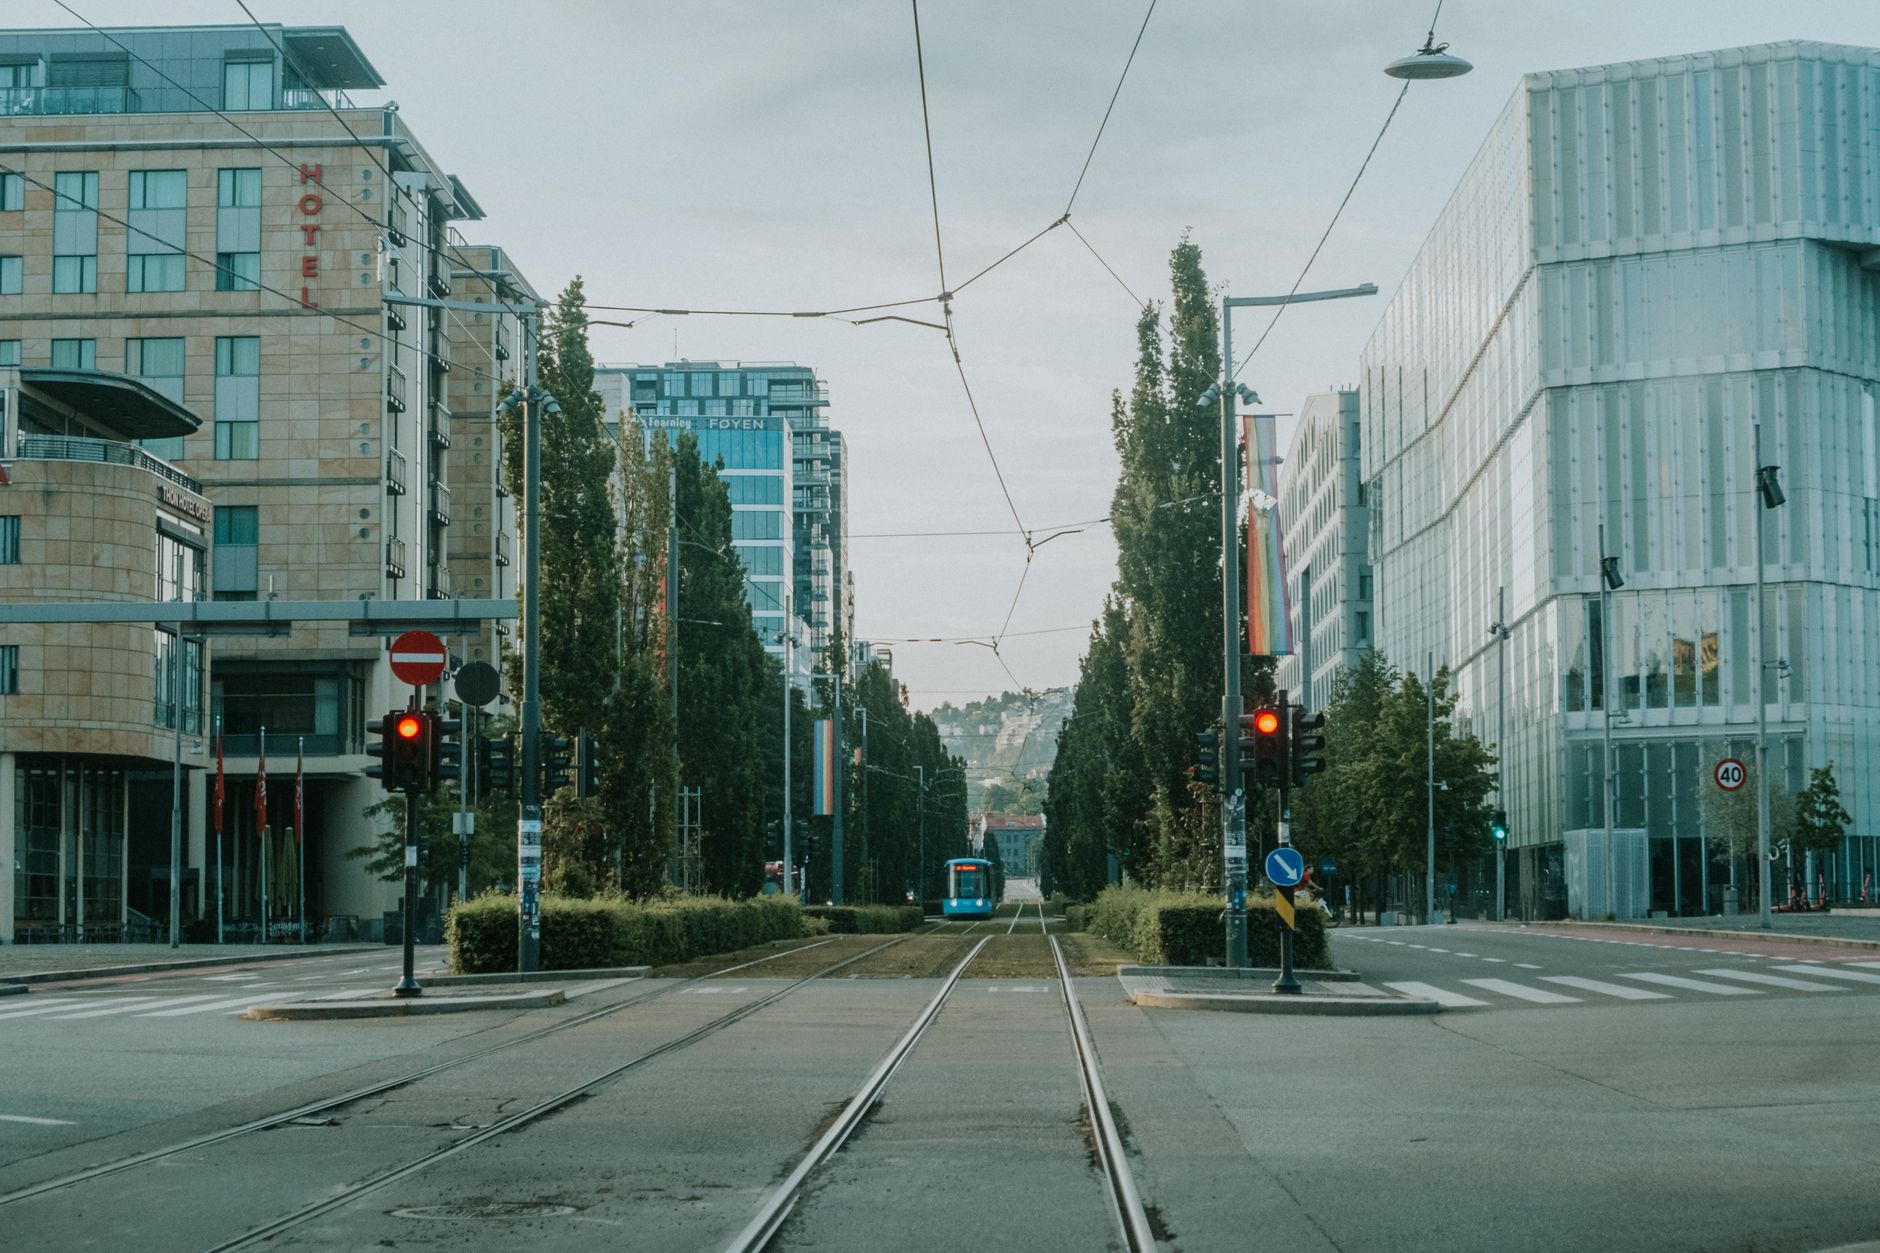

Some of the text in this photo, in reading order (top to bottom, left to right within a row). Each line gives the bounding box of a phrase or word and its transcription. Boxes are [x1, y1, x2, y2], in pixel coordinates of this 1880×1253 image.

[300, 163, 322, 308] HOTEL
[648, 416, 691, 430] Fearnley
[709, 419, 764, 430] FØYEN
[163, 486, 179, 507] THON
[179, 493, 196, 516] HOTEL
[1720, 766, 1742, 783] 40
